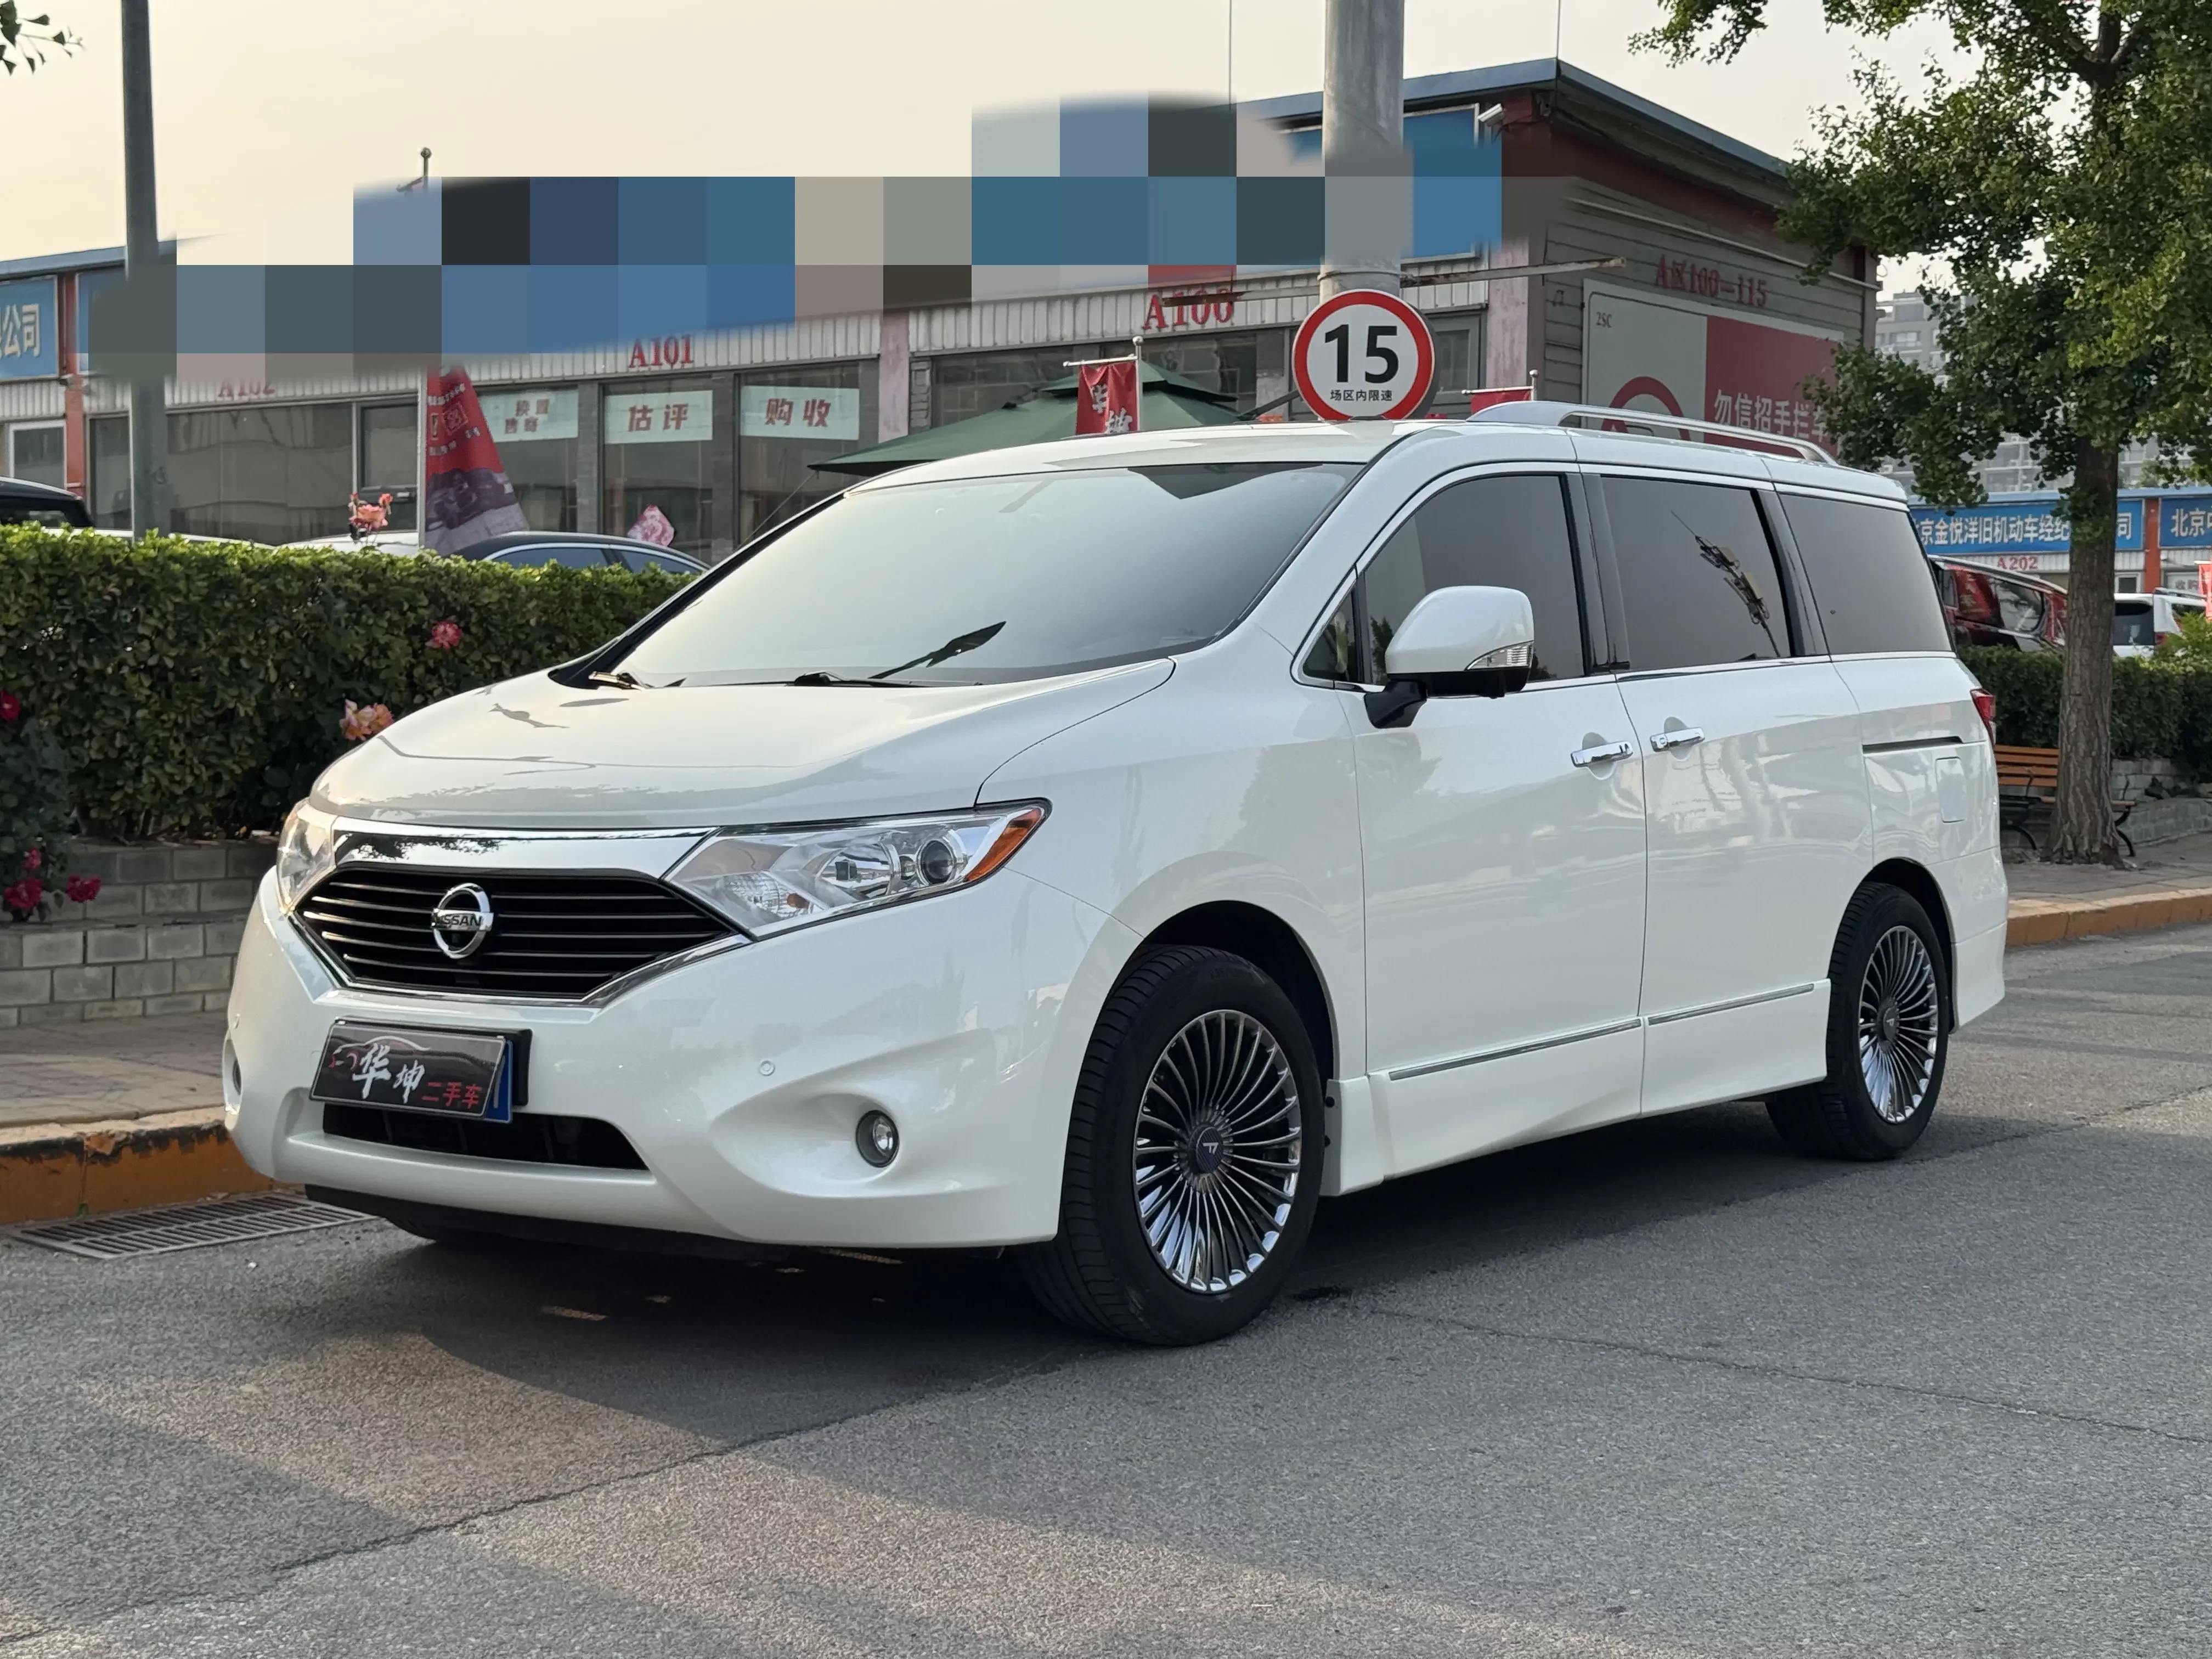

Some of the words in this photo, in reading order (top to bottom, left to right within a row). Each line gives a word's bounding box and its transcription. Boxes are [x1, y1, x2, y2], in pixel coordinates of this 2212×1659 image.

[1142, 287, 1234, 330] A100
[0, 303, 41, 358] 公司
[629, 335, 695, 368] A101
[1324, 324, 1399, 384] 15
[1330, 389, 1392, 402] 场区内限速
[1997, 556, 2038, 570] A202
[352, 1042, 425, 1104] 华坤
[421, 1081, 483, 1109] 二手车
